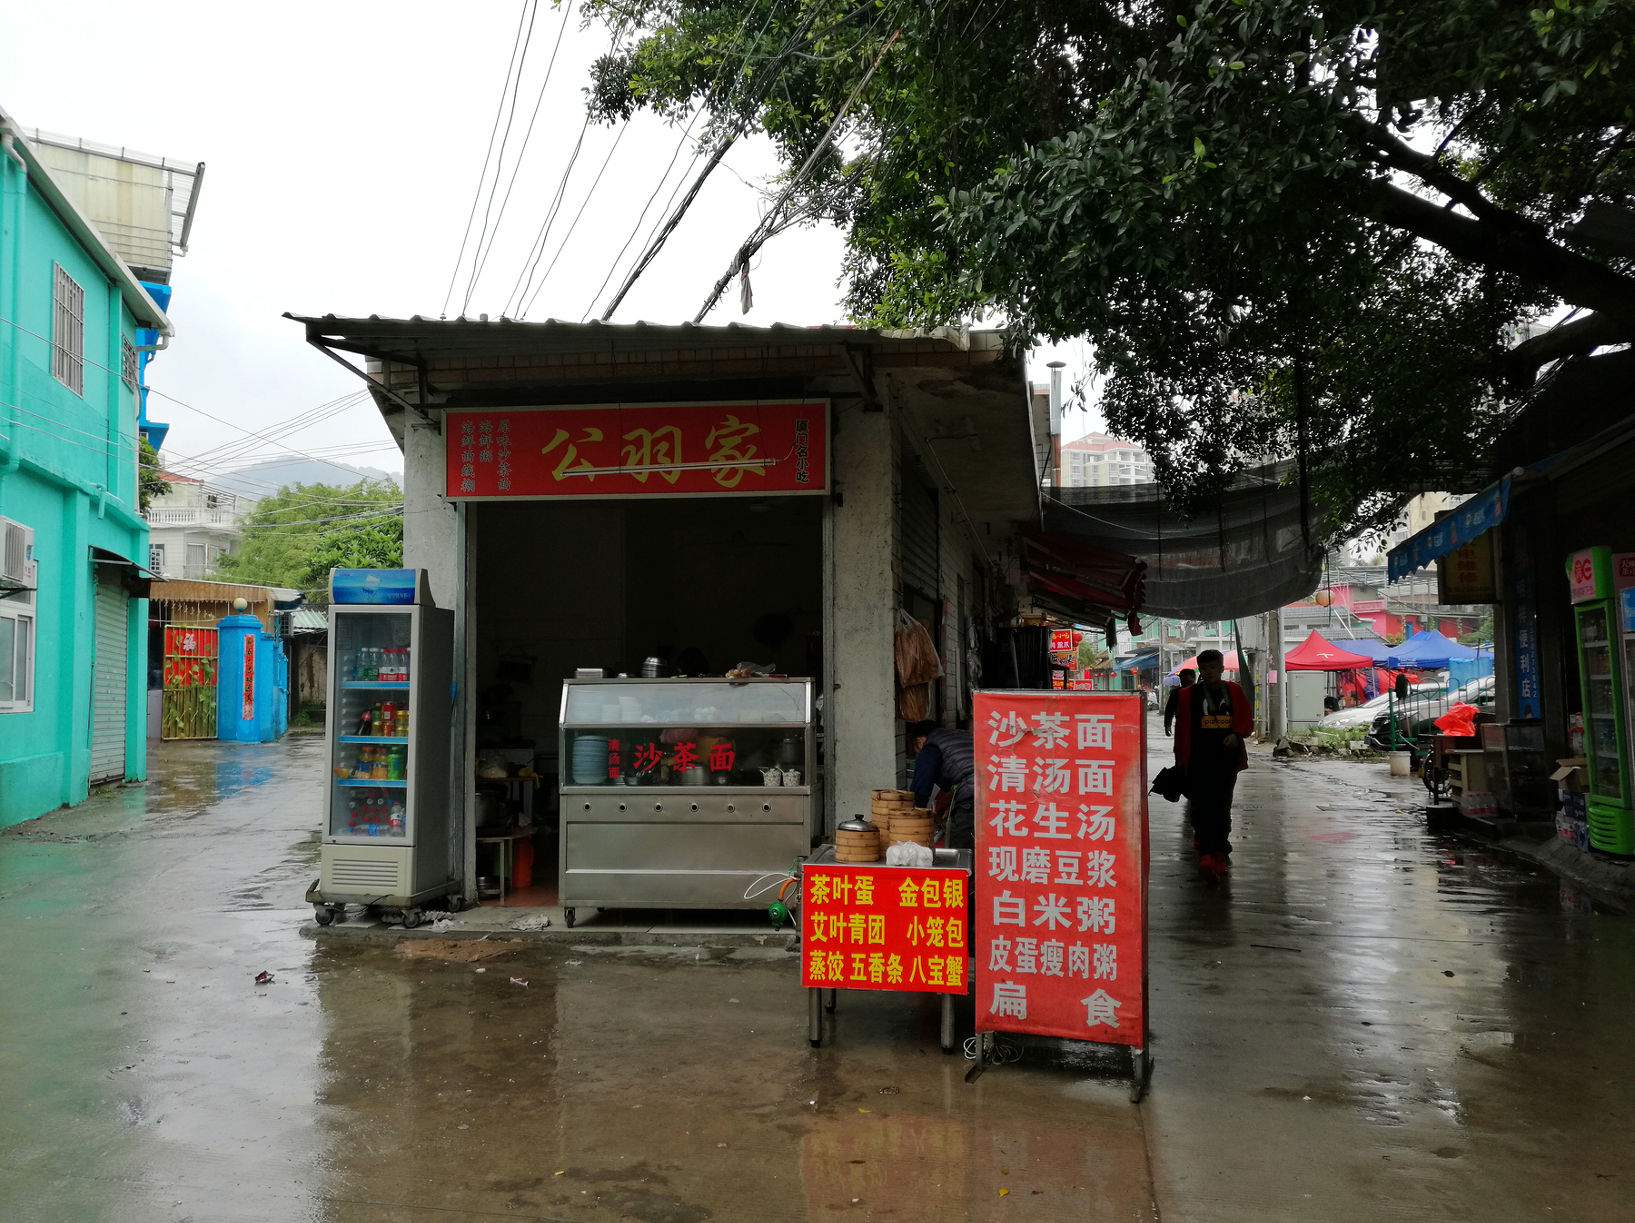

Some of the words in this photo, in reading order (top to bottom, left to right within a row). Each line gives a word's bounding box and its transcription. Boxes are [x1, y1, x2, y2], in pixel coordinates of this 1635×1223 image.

[541, 414, 767, 489] 公羽家
[795, 419, 809, 484] 厦门名小吃
[987, 710, 1116, 750] 沙茶面
[608, 739, 620, 779] 清汤面
[632, 741, 736, 773] 沙茶面
[987, 754, 1116, 796] 清汤面
[988, 799, 1117, 841] 花生汤
[988, 845, 1117, 888] 现磨豆浆
[809, 875, 875, 906] 茶叶蛋
[899, 877, 964, 909] 金包银
[992, 890, 1116, 935] 白米粥
[809, 913, 885, 945] 艾叶青团
[906, 916, 964, 948] 小笼包
[809, 950, 845, 981] 蒸饺
[850, 952, 903, 984] 五香条
[909, 955, 963, 987] 八宝蟹
[988, 935, 1117, 982] 皮蛋瘦肉粥
